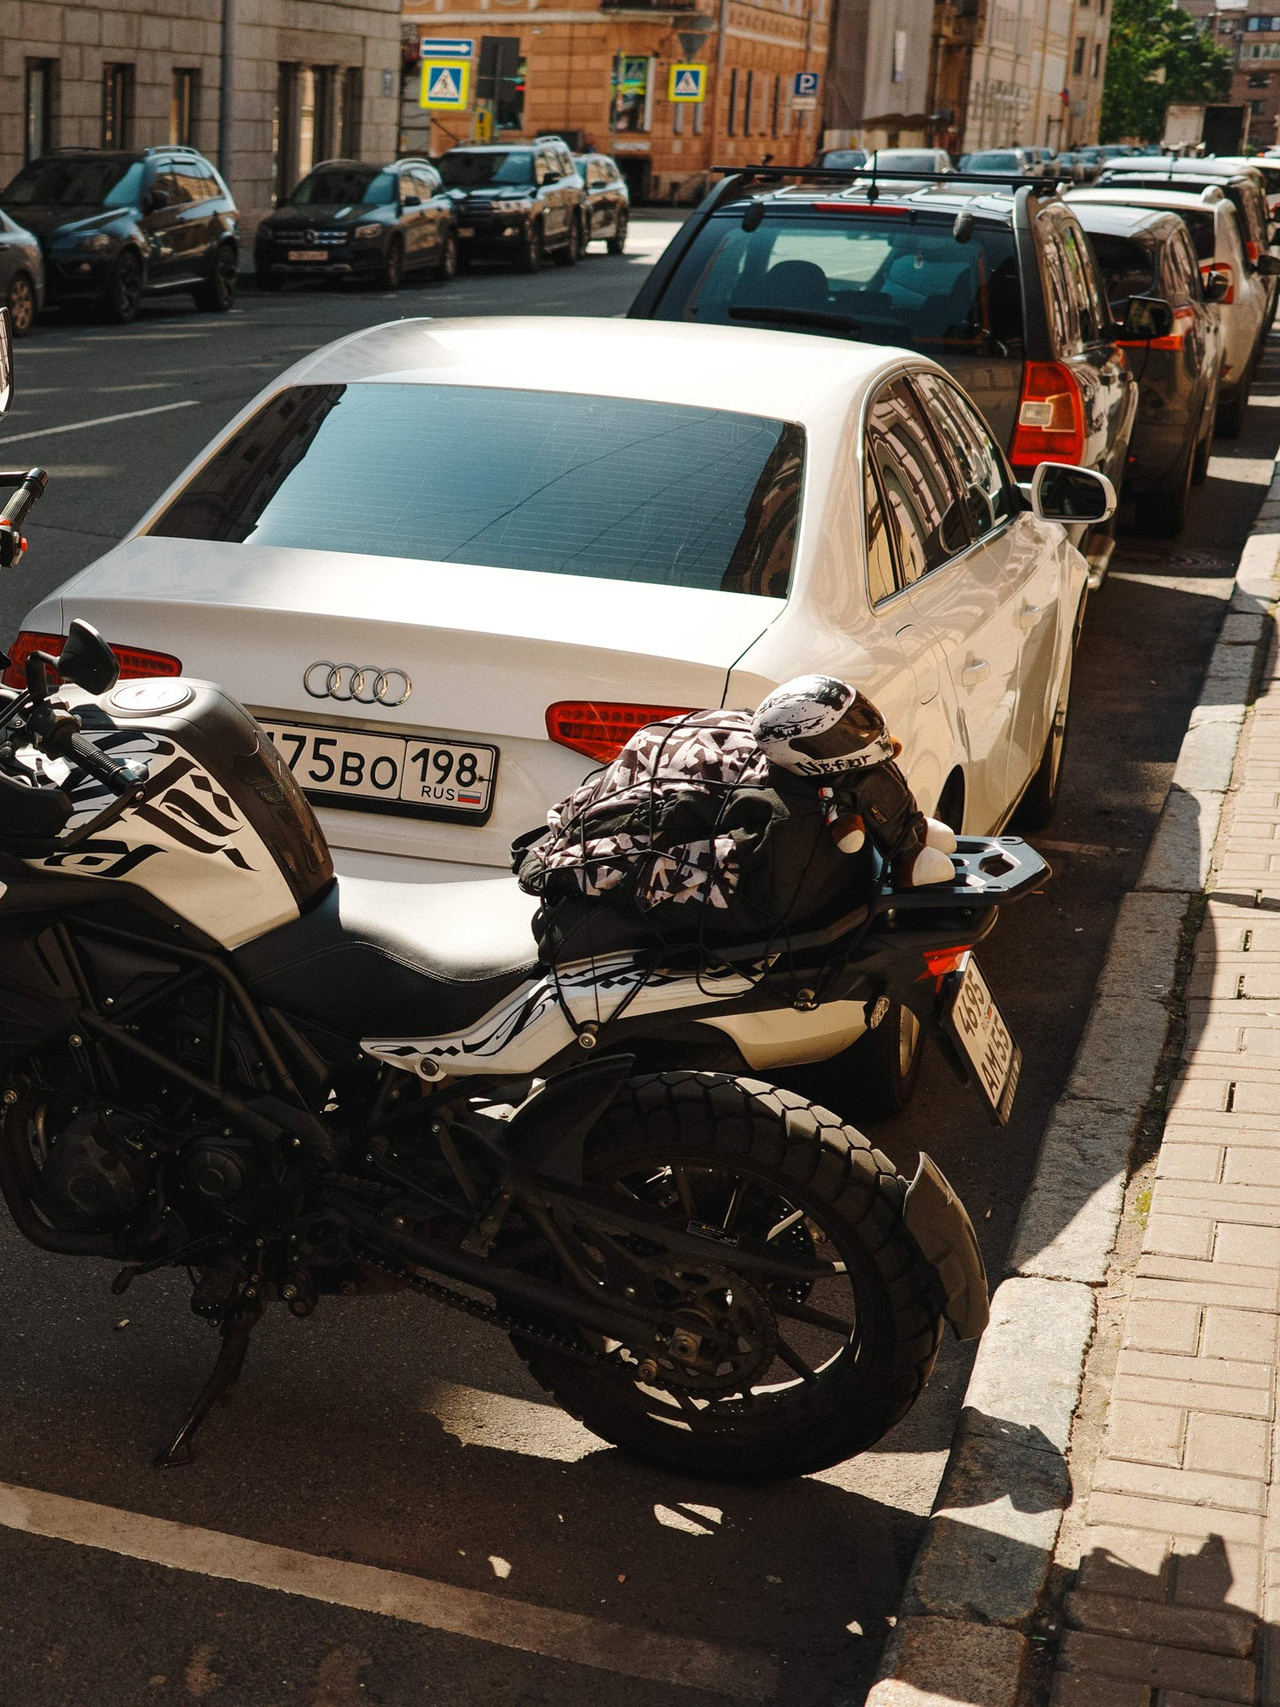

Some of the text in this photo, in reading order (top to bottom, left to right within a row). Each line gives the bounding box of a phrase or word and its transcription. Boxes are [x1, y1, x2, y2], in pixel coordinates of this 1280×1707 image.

[266, 731, 478, 790] 75BO 198
[421, 785, 455, 801] RUS
[958, 969, 985, 1037] 4695
[981, 1015, 1010, 1100] AM 55
